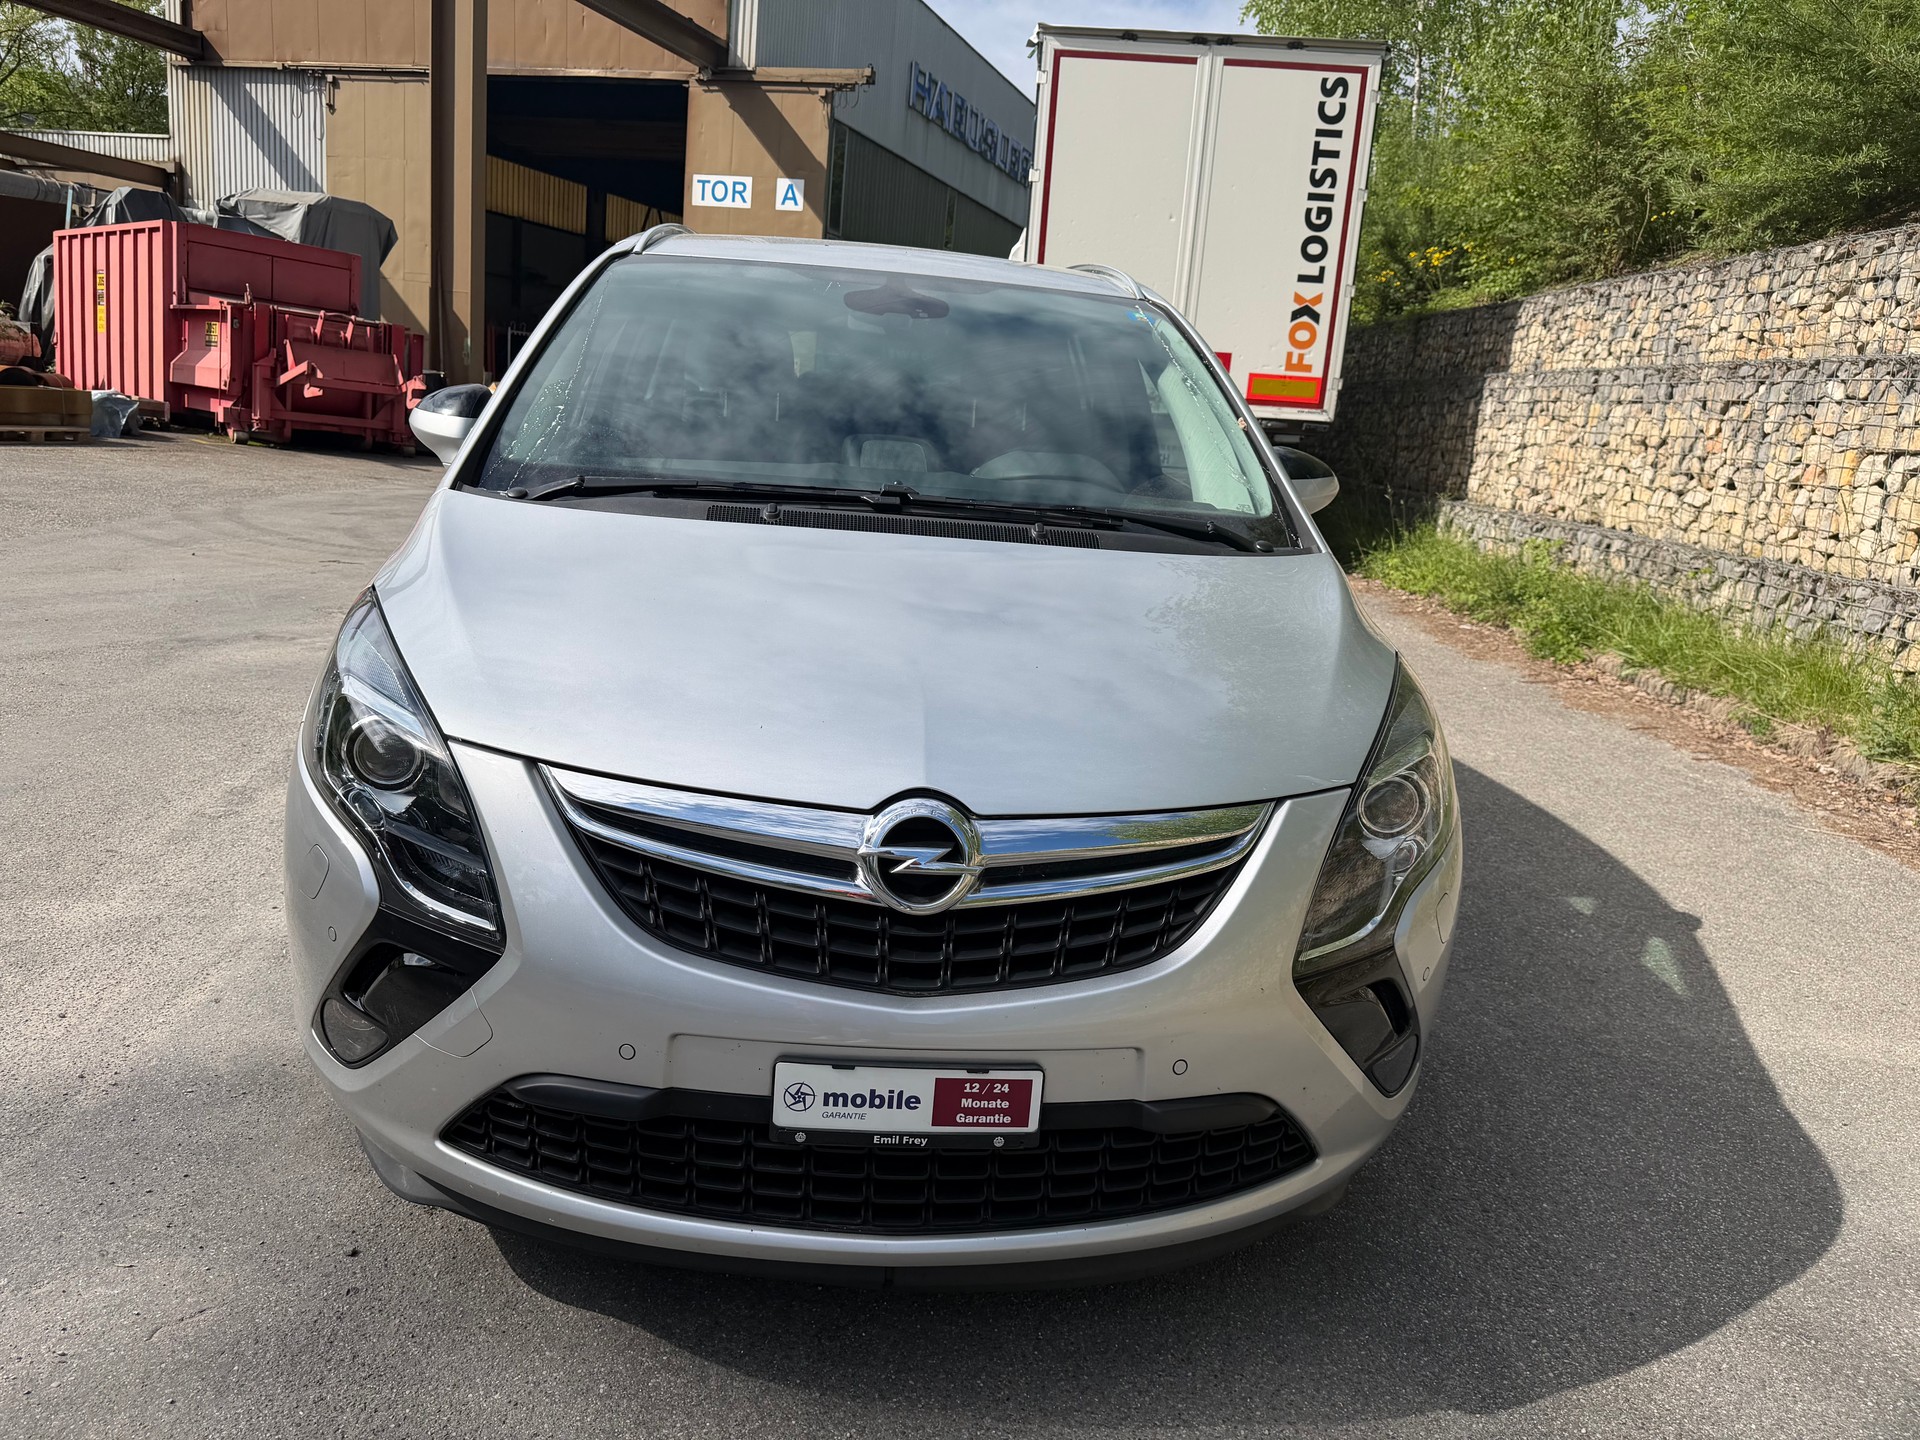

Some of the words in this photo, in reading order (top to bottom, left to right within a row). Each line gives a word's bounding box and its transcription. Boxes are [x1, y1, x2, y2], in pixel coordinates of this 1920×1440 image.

[909, 60, 1032, 189] HAEUSLER
[696, 179, 747, 203] TOR
[1297, 76, 1349, 284] LOGISTICS
[780, 183, 799, 206] A
[1284, 291, 1324, 373] FOX
[823, 1088, 921, 1110] mobile
[963, 1082, 980, 1093] 12
[981, 1083, 991, 1095] /
[993, 1083, 1010, 1093] 24
[961, 1098, 1010, 1109] Monate
[821, 1111, 867, 1120] GARANTIE
[956, 1113, 1012, 1124] Garantie
[873, 1135, 900, 1144] Emil
[902, 1136, 928, 1147] Frey
